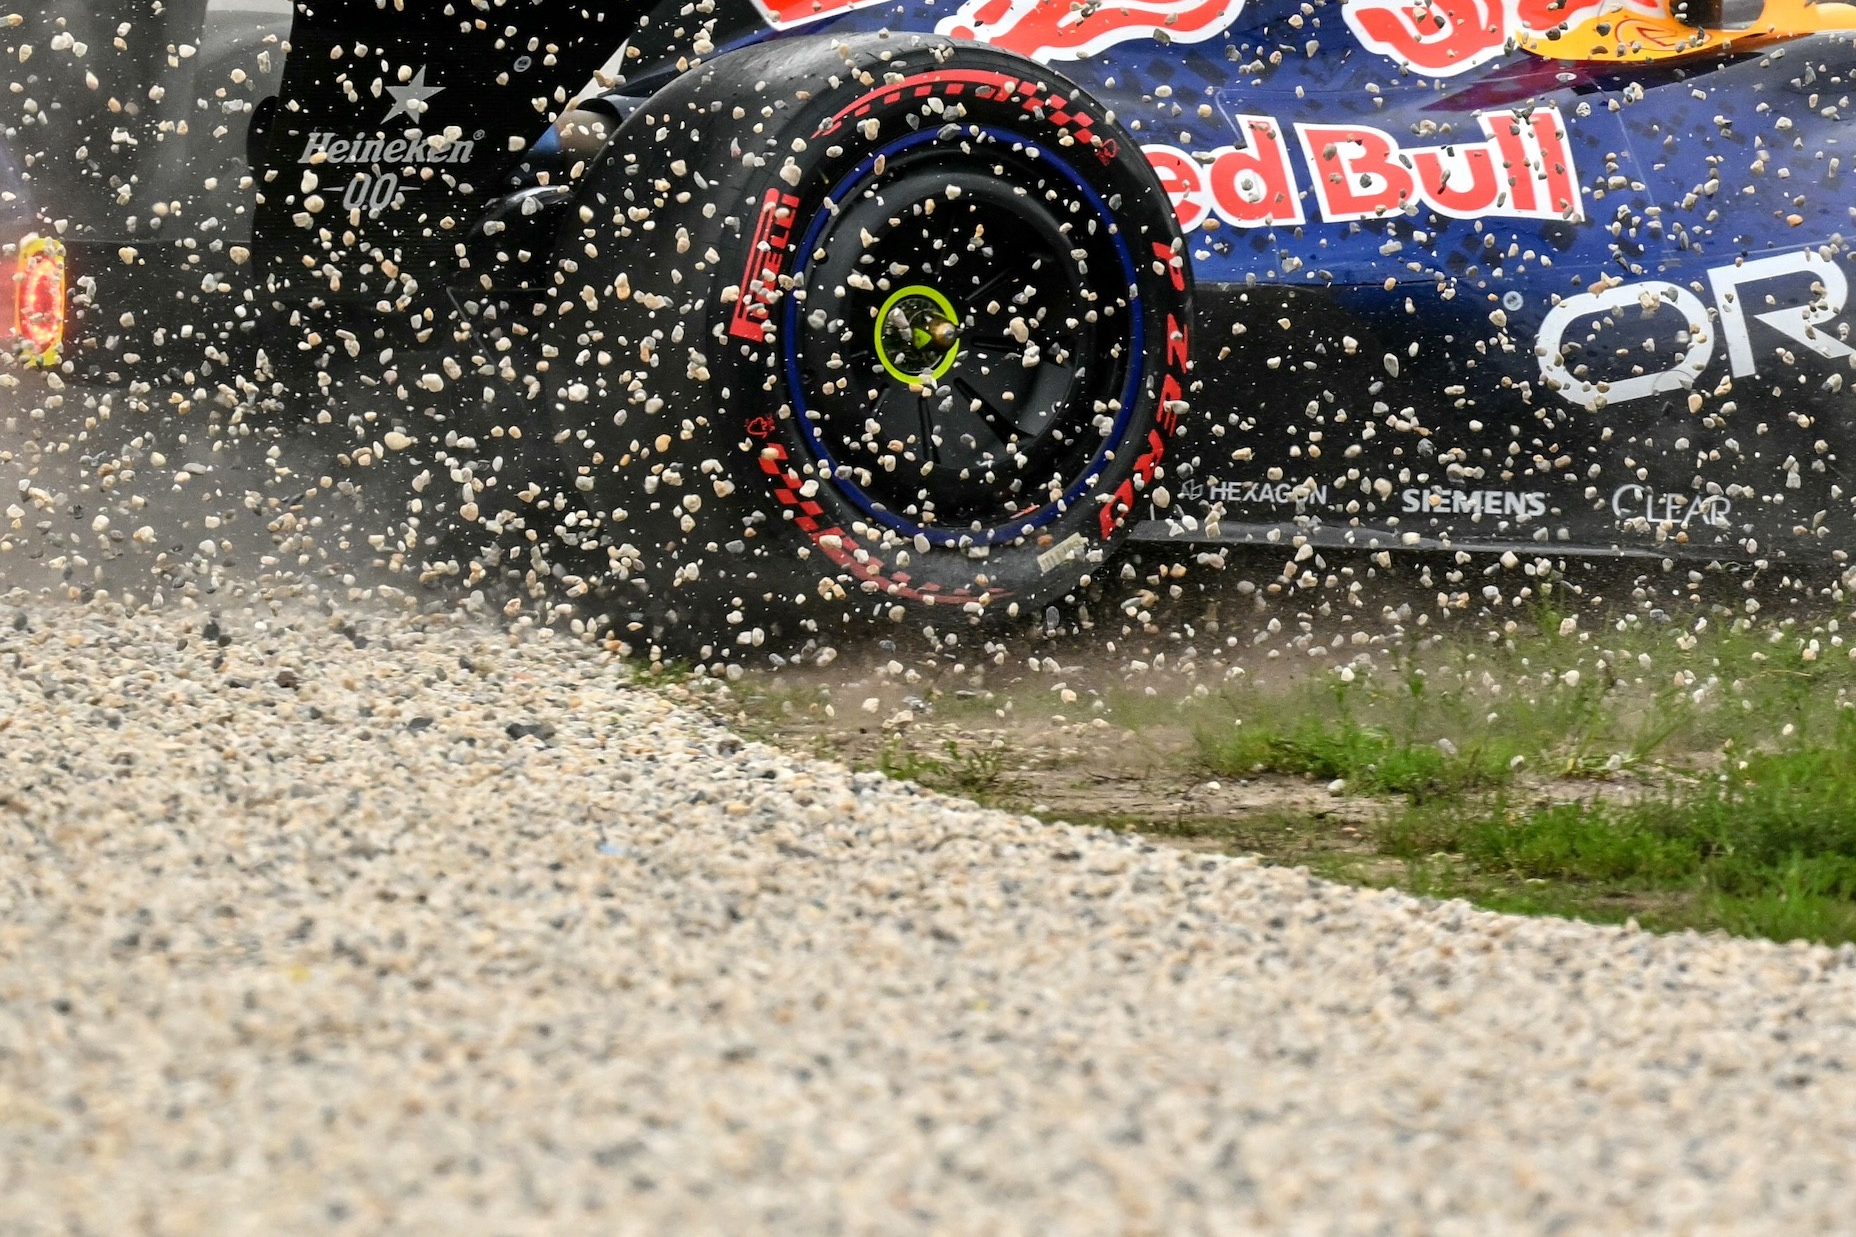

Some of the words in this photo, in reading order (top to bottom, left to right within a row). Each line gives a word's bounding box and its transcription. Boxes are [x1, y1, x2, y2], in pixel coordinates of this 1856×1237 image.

[1142, 114, 1306, 230] ed
[1293, 107, 1585, 223] Bull
[1401, 489, 1547, 517] SIEMENS
